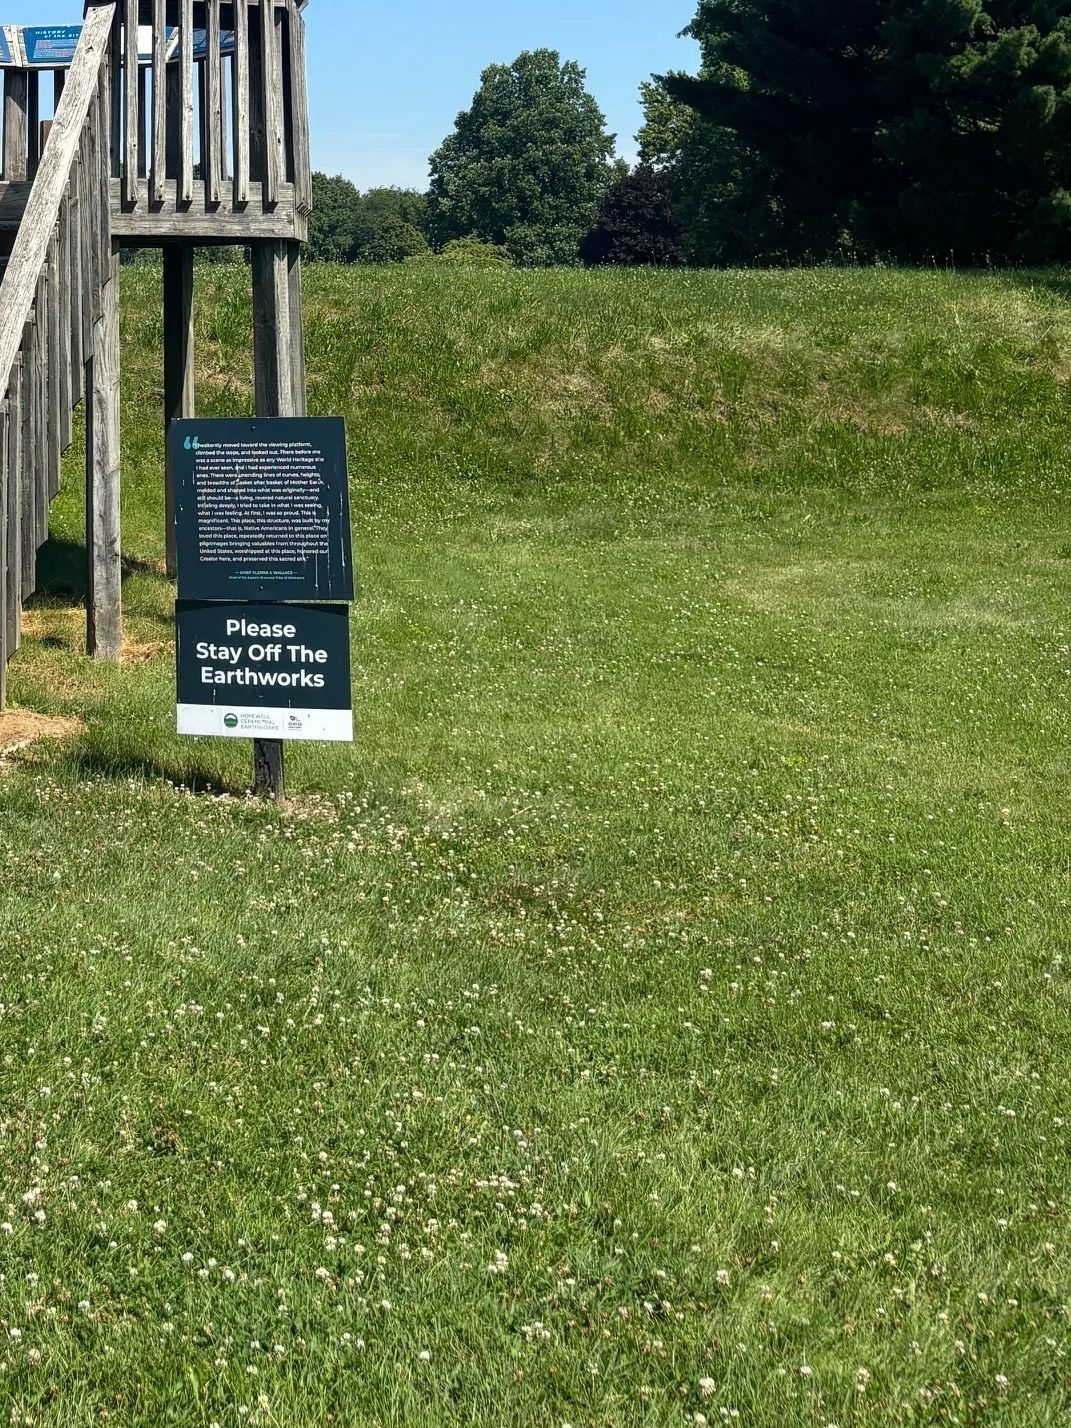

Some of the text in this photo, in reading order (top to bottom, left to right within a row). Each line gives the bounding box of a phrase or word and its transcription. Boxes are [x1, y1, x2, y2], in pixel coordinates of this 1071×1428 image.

[226, 619, 296, 637] Please
[196, 642, 328, 664] Stay Off The
[201, 666, 325, 687] Earthworks
